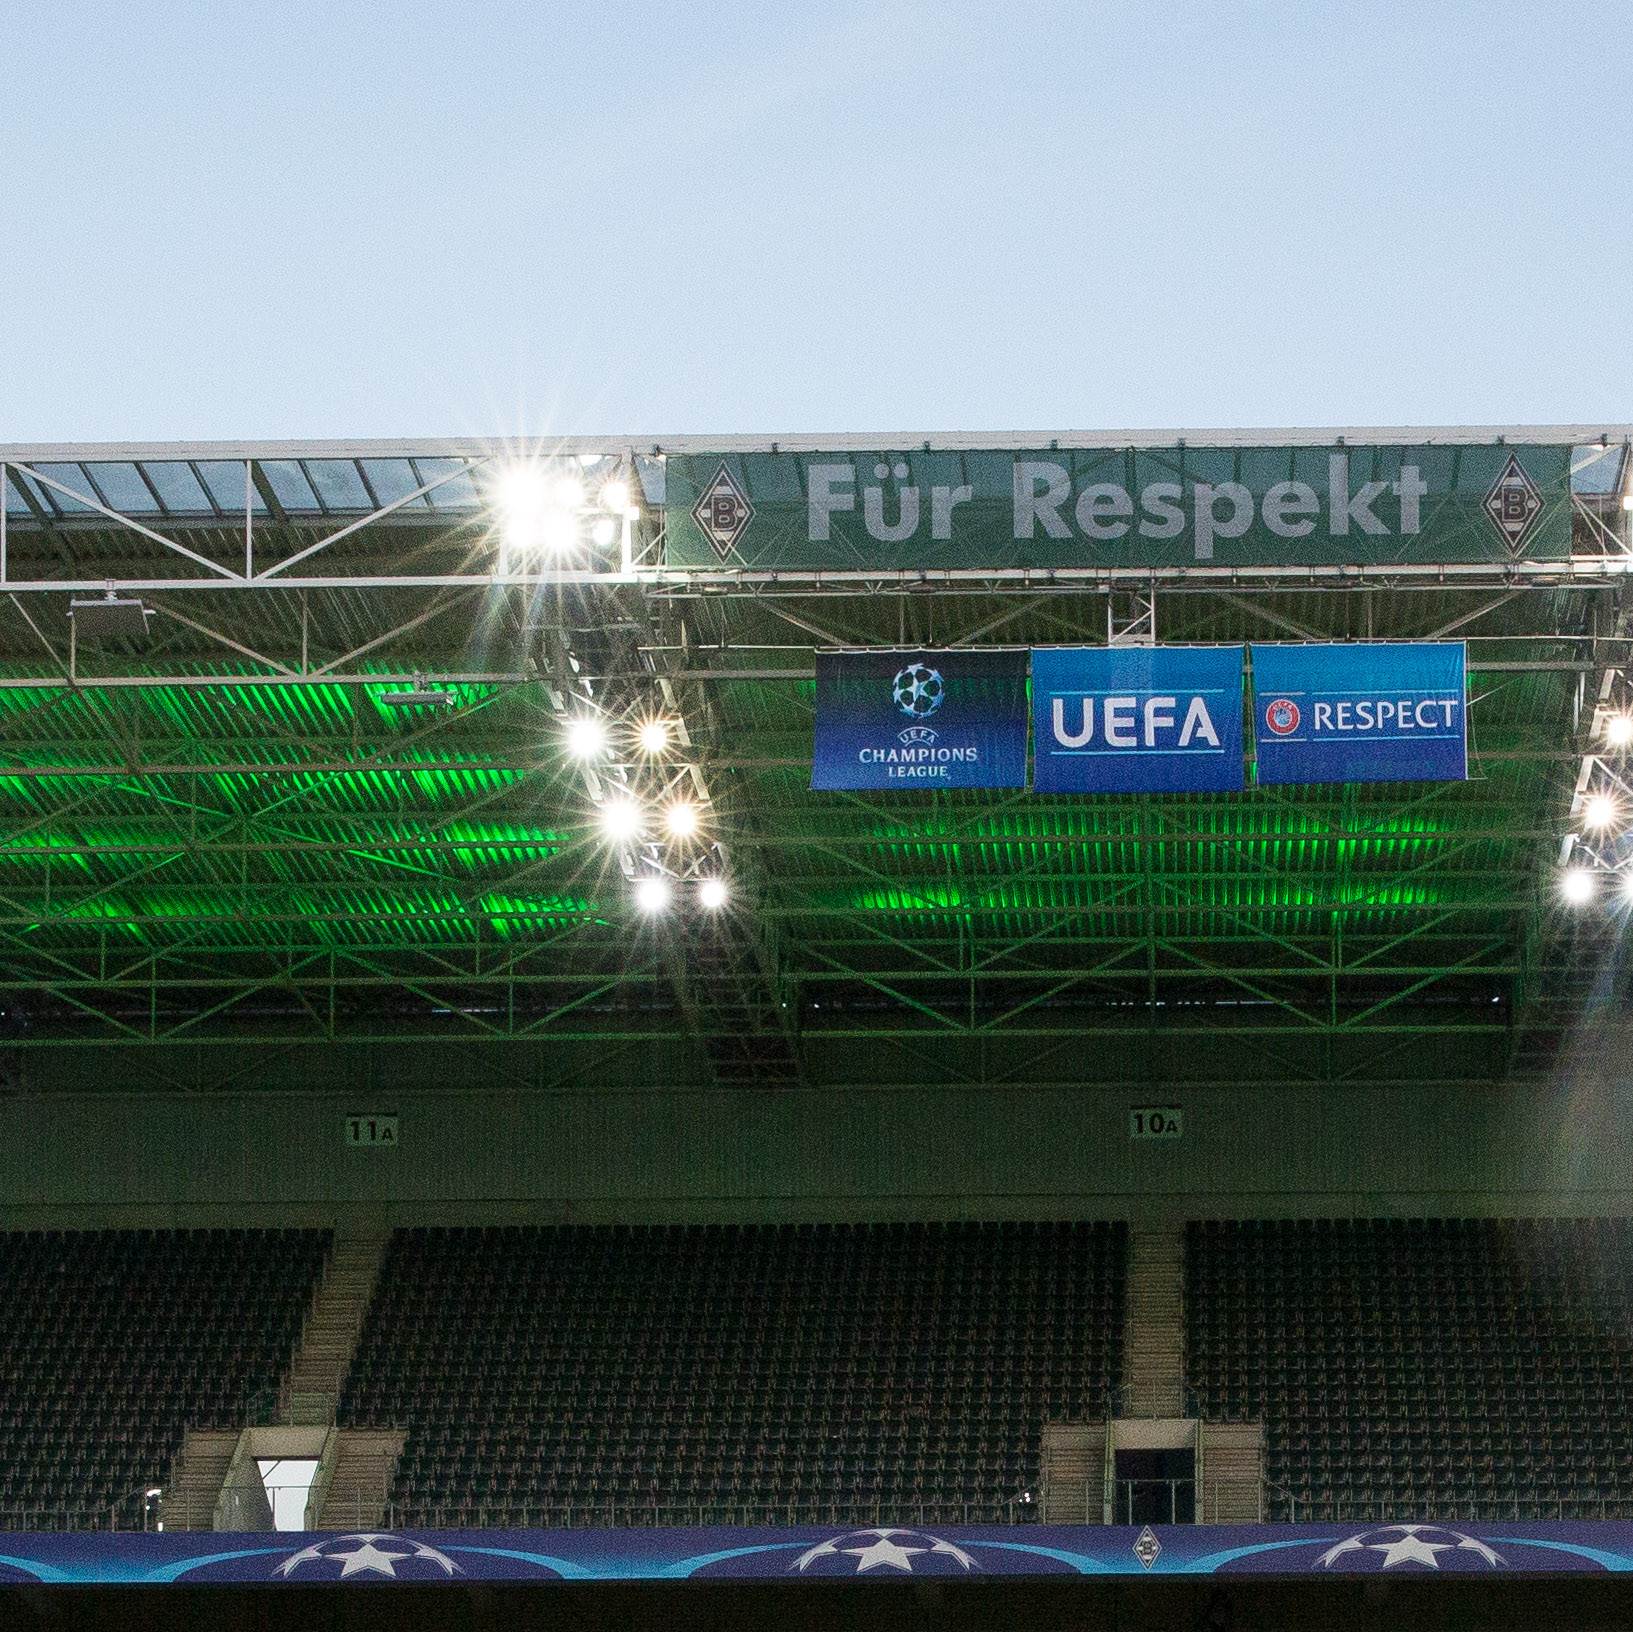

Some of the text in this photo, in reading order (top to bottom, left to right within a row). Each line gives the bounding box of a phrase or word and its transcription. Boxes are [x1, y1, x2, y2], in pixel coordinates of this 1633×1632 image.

[808, 454, 1427, 560] Für Respekt
[1053, 696, 1220, 750] UEFA
[1314, 700, 1458, 730] RESPECT
[897, 728, 938, 744] UEFA
[859, 747, 977, 764] CHAMPIONS
[888, 766, 948, 778] LEAGUE
[349, 1120, 394, 1141] 11A
[1132, 1113, 1178, 1133] 10A
